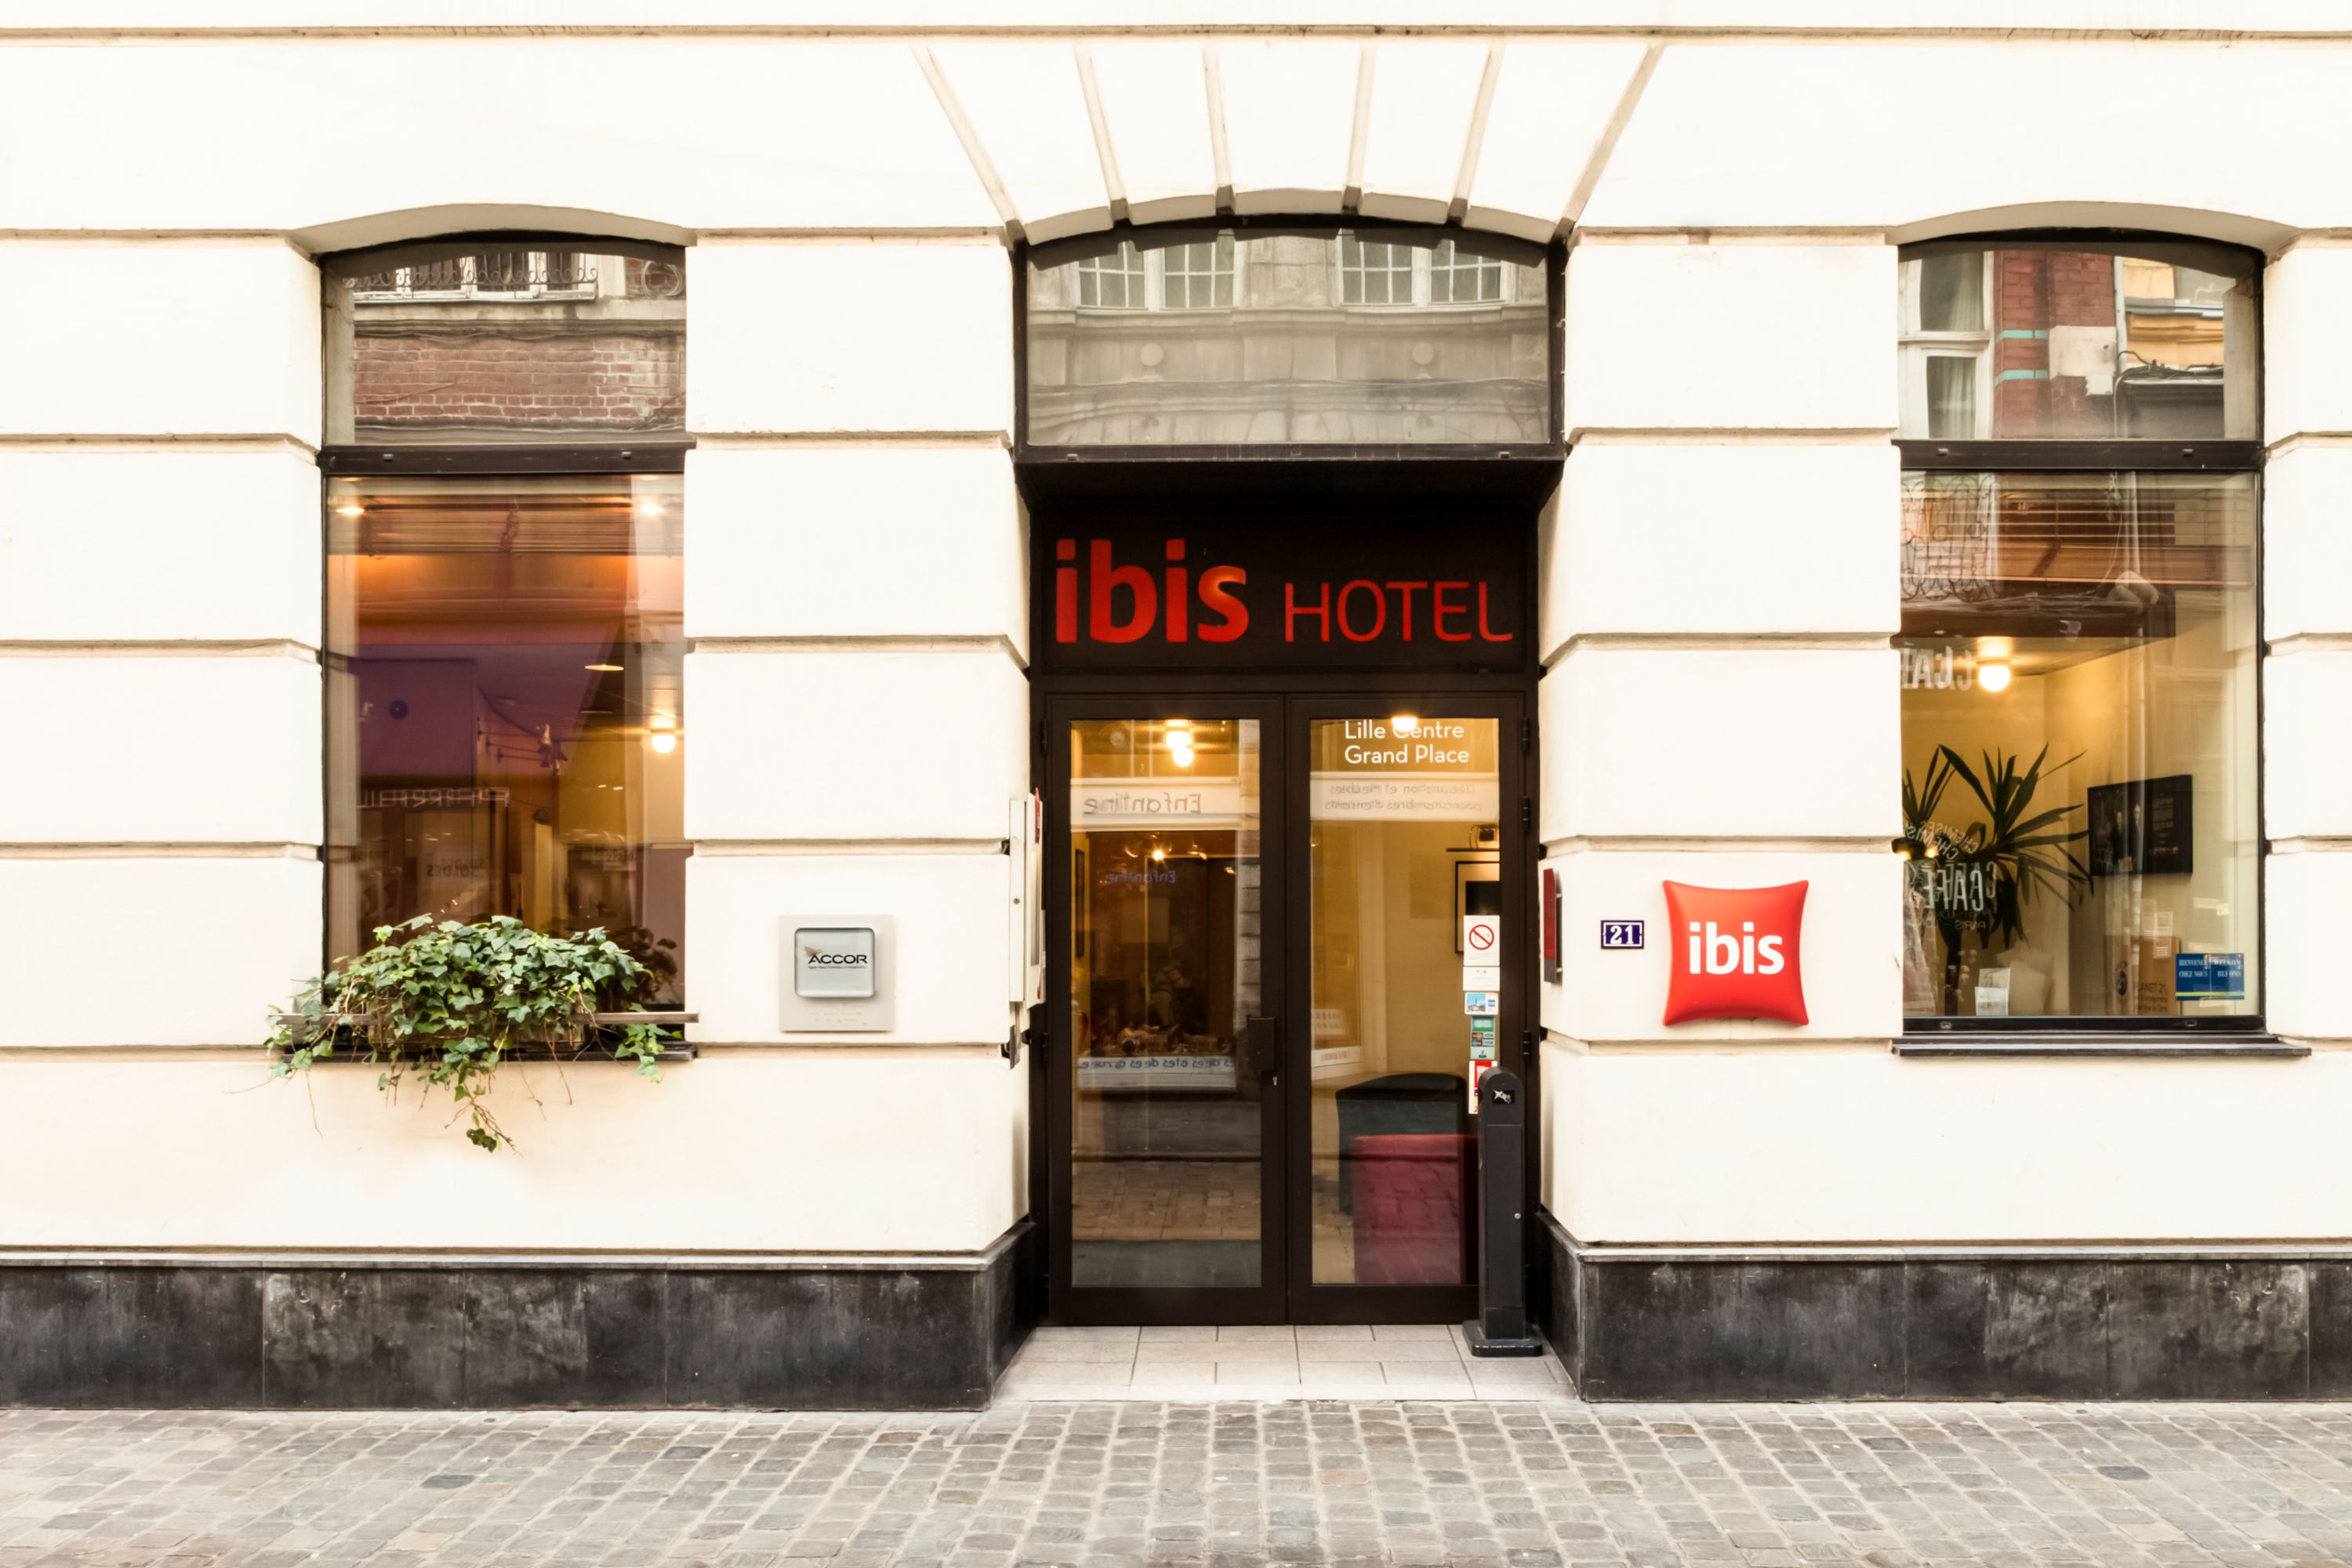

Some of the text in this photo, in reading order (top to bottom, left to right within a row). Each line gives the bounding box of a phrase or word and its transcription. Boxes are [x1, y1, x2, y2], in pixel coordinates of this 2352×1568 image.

[1055, 539, 1514, 644] ibis HOTEL
[1345, 719, 1386, 739] Lille
[1345, 744, 1470, 764] Grand Place
[1610, 925, 1635, 945] 21
[1690, 921, 1785, 975] ibis
[808, 954, 868, 964] ACCOR
